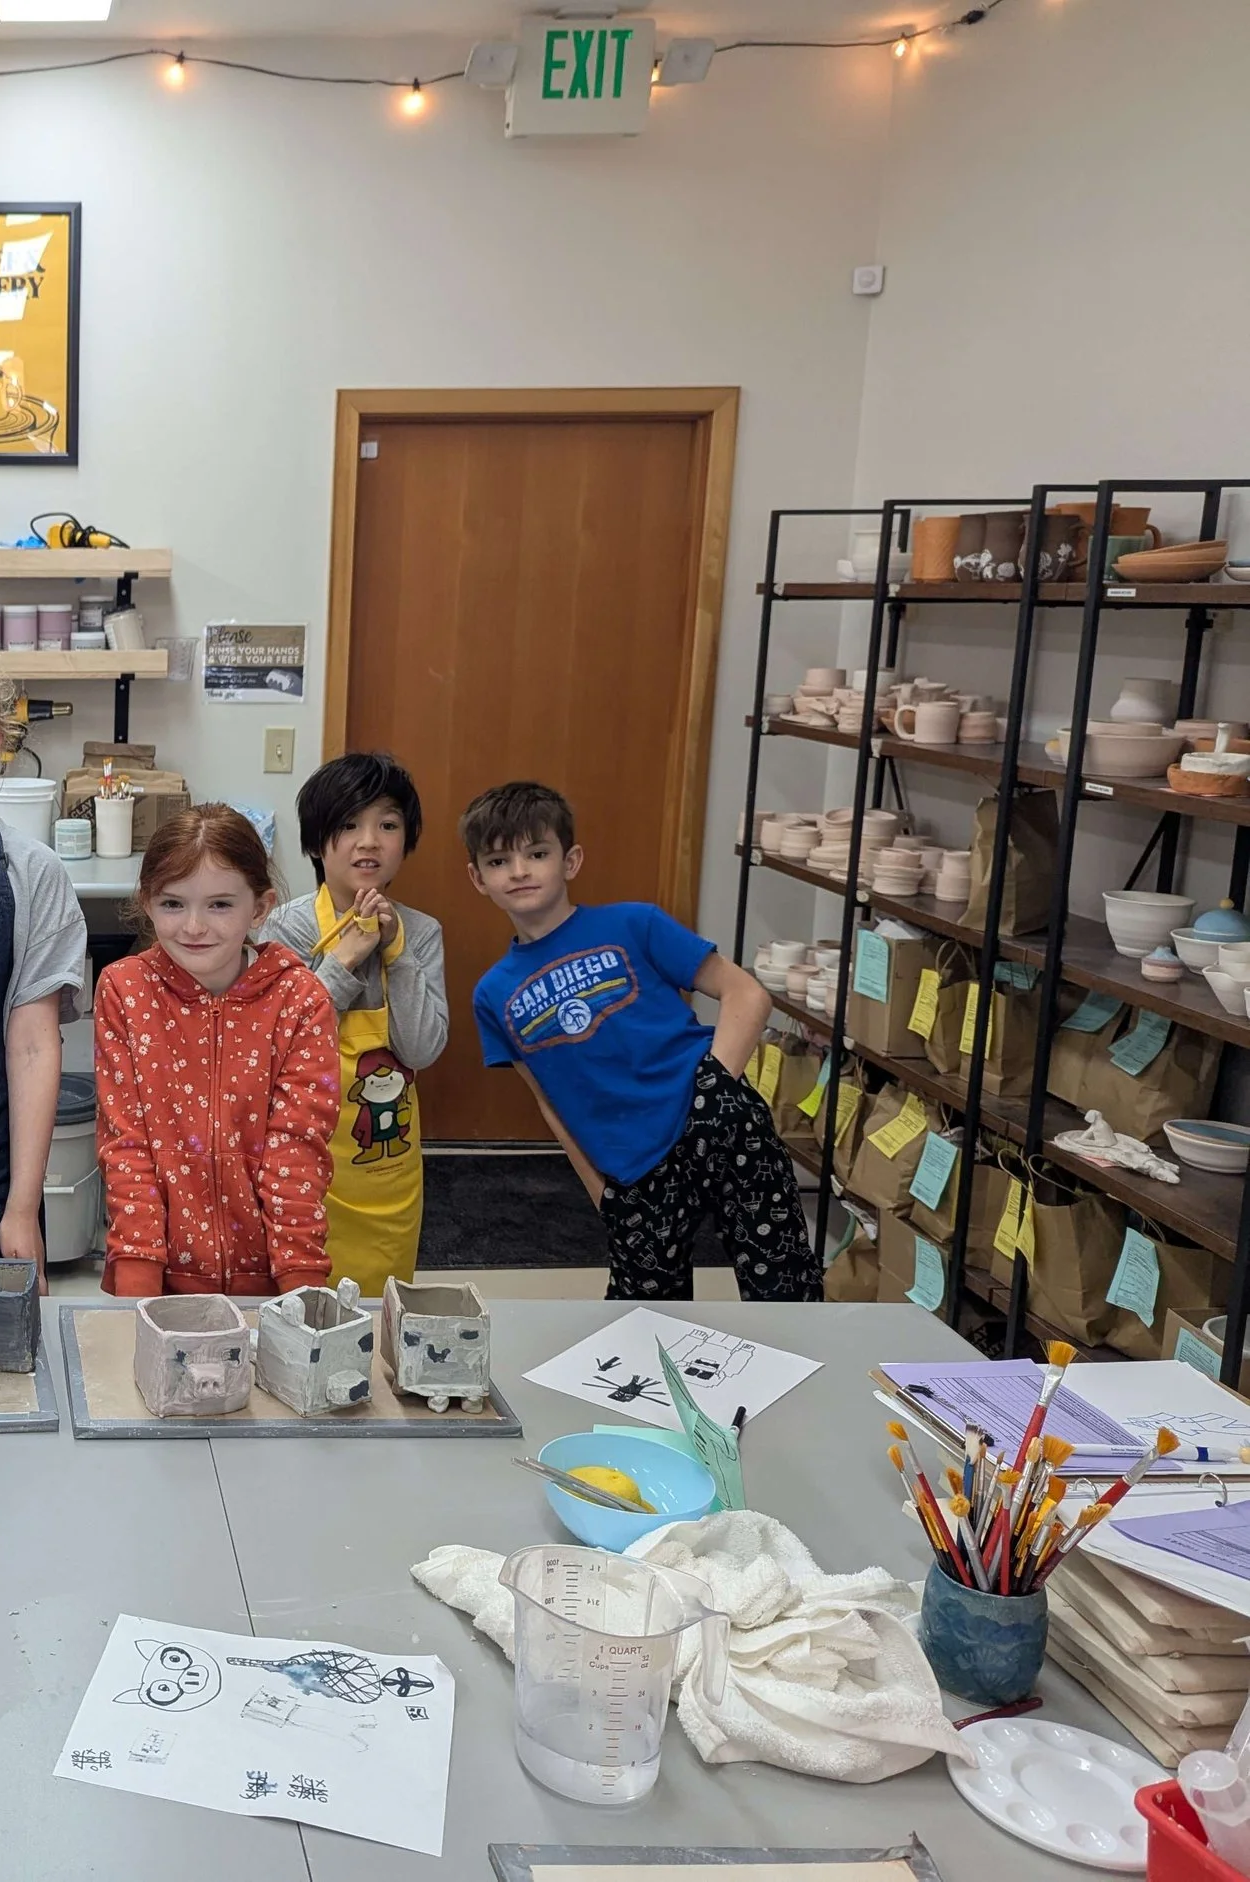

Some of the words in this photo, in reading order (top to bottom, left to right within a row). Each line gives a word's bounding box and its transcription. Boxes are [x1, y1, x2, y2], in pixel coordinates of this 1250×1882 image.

[541, 29, 634, 99] EXIT
[207, 626, 254, 644] Please
[208, 647, 236, 655] RINSE
[238, 647, 265, 655] YOUR
[267, 647, 300, 655] HANDS
[218, 656, 242, 664] WIPE
[246, 656, 273, 664] YOUR
[276, 656, 299, 664] FEET
[510, 978, 549, 1019] SAN
[549, 950, 619, 992] DIEGO
[530, 975, 602, 1018] CALIFORNIA
[608, 1645, 644, 1655] QUART
[641, 1654, 650, 1662] 32
[589, 1661, 610, 1671] Cups
[637, 1690, 646, 1698] 24
